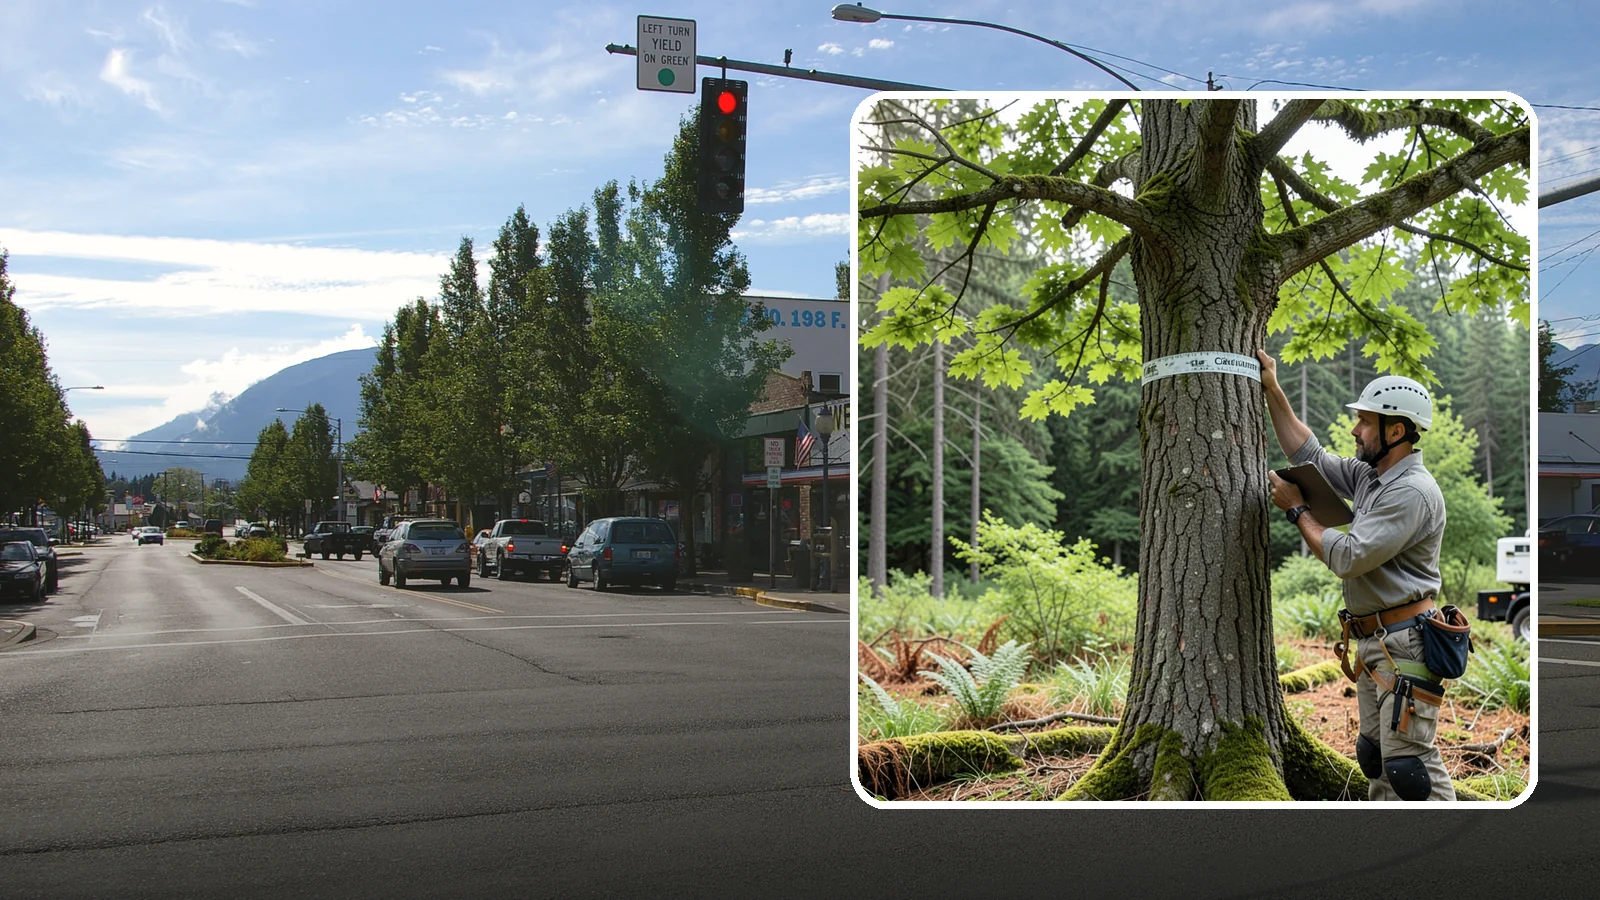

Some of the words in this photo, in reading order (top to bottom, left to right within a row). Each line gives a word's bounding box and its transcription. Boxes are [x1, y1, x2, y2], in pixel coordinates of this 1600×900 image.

[643, 24, 663, 34] LEFT
[668, 26, 690, 36] TURN
[652, 38, 682, 51] YIELD
[644, 53, 656, 63] ON
[661, 55, 689, 66] GREEN
[791, 309, 826, 327] 198
